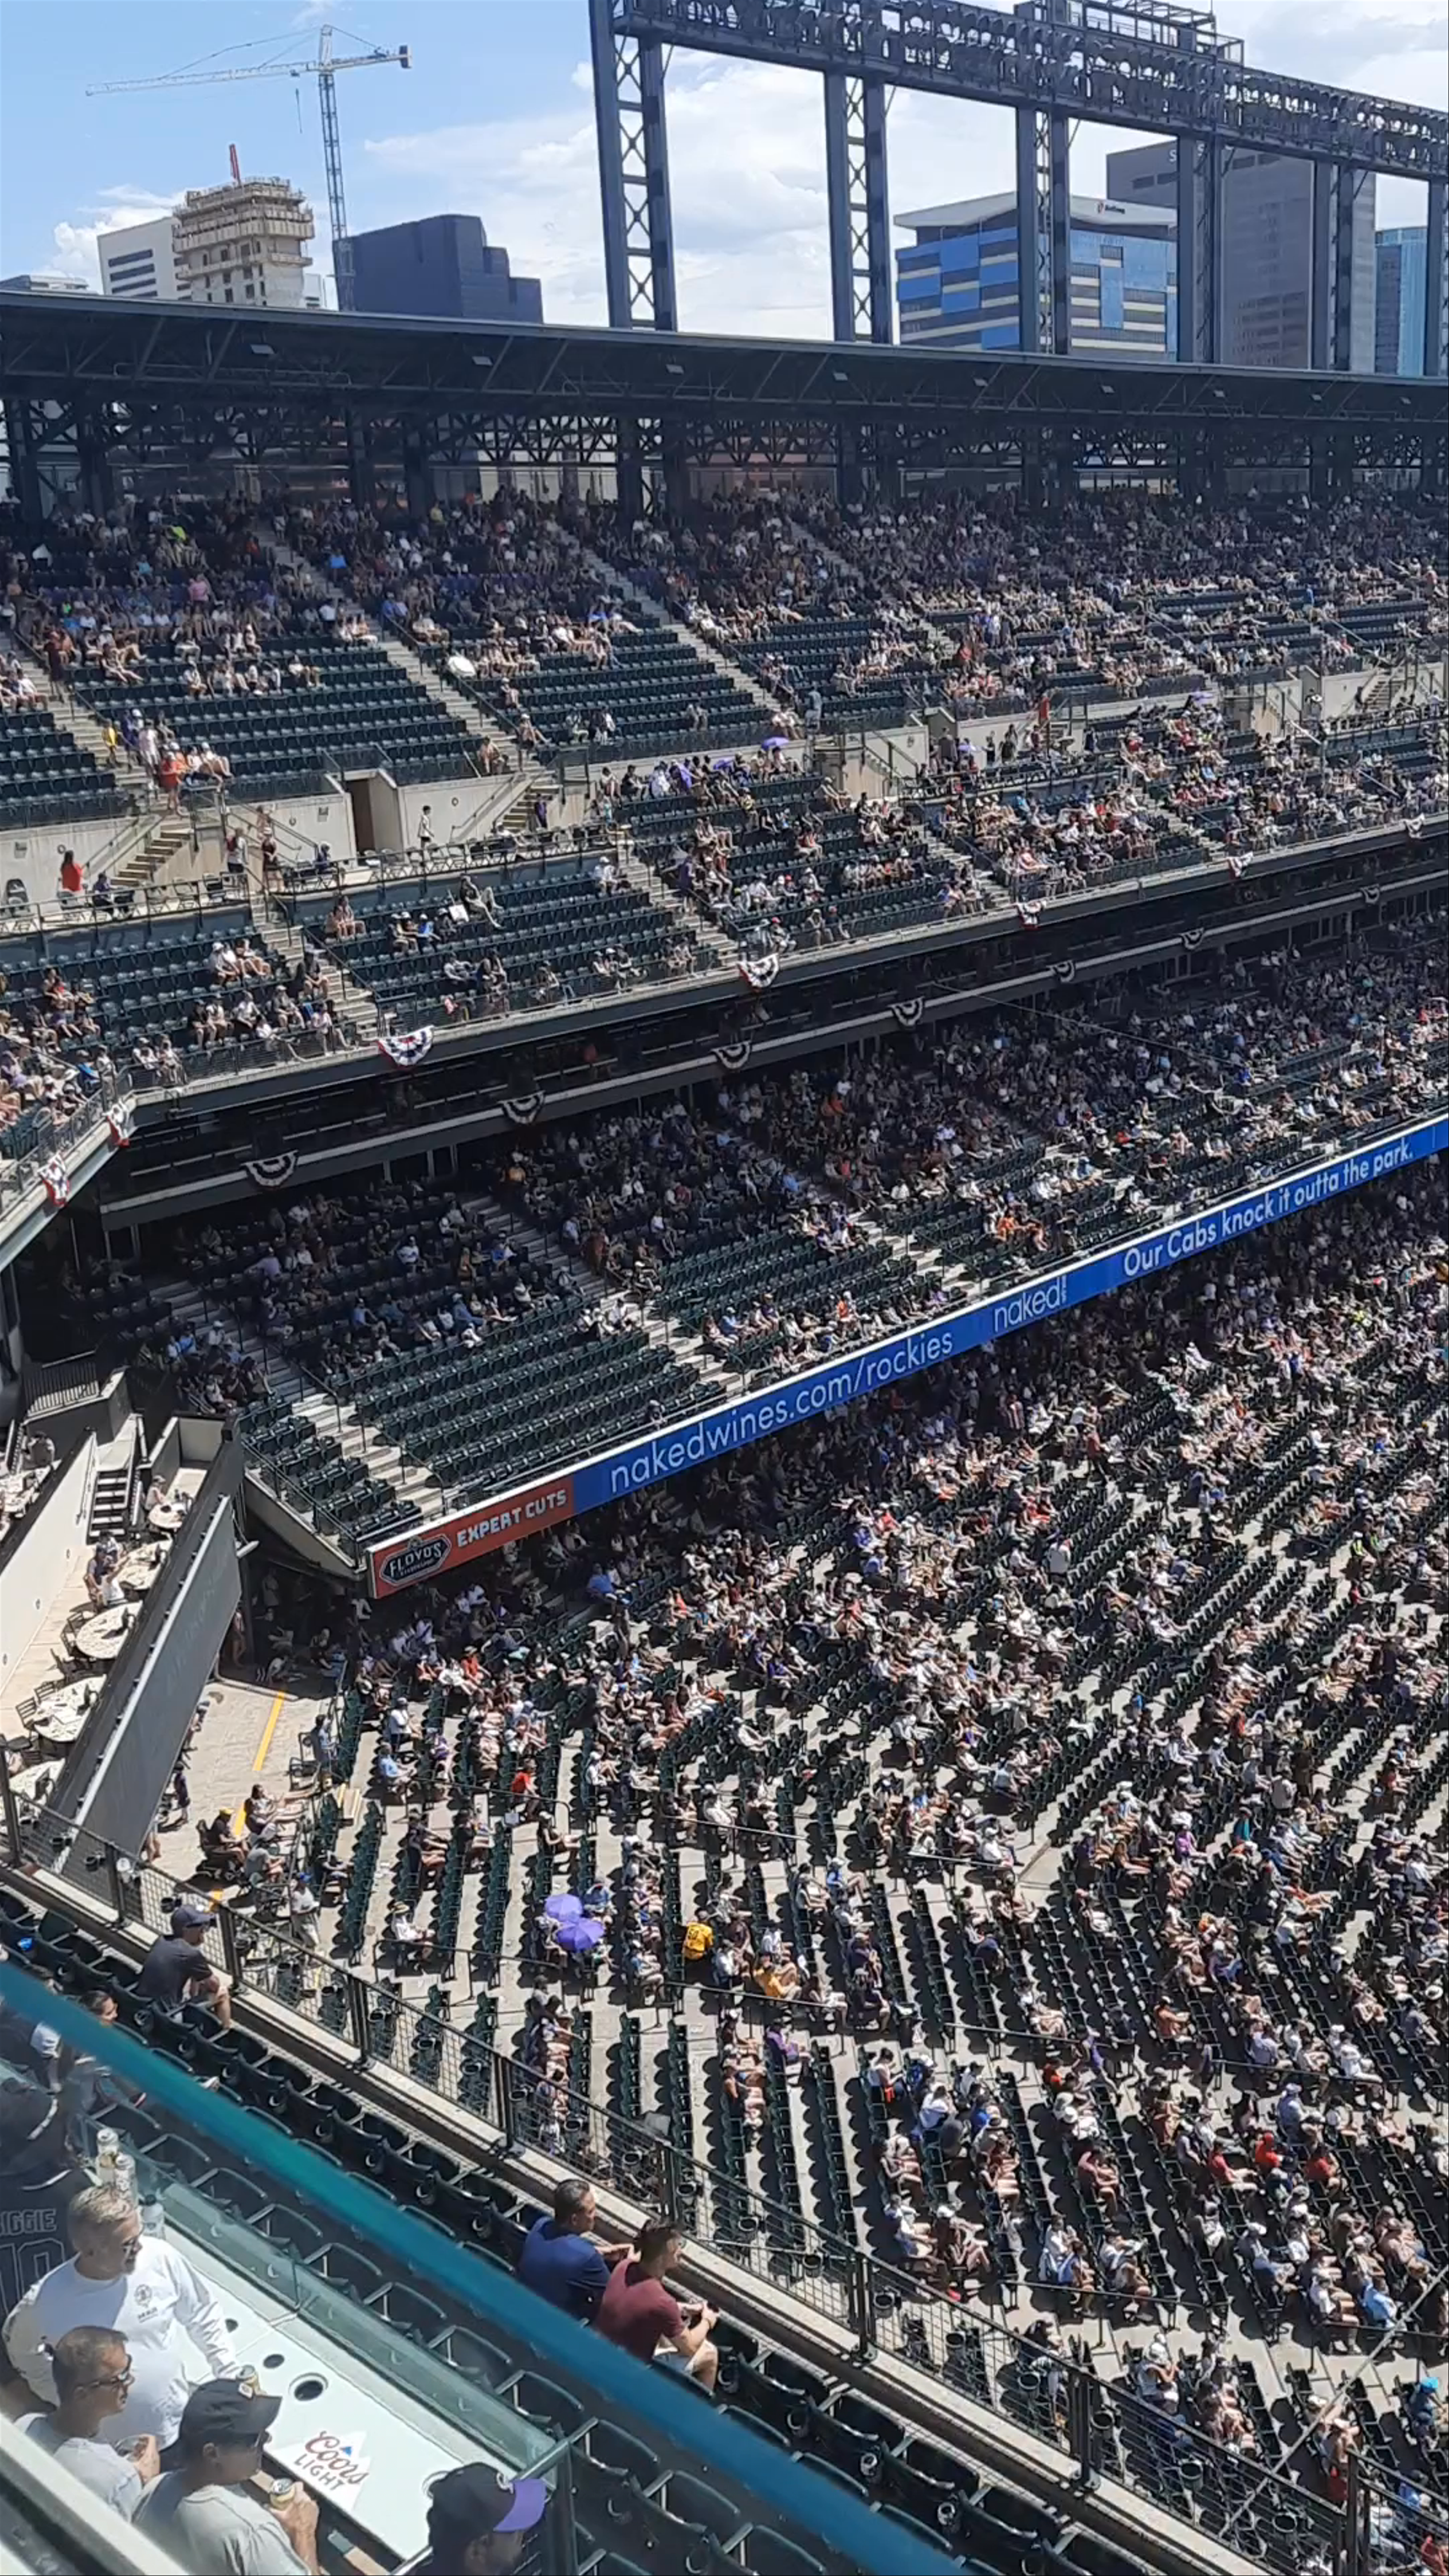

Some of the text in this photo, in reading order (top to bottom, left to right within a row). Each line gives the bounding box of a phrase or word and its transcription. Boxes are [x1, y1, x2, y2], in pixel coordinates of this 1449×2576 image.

[1124, 1137, 1414, 1276] Our Cabs knock it outta the park.
[611, 1332, 953, 1493] nakedwines.com/rockies
[457, 1489, 567, 1547] EXPERT CUTS
[294, 2453, 345, 2490] LIGHT
[305, 2430, 370, 2484] Coors
